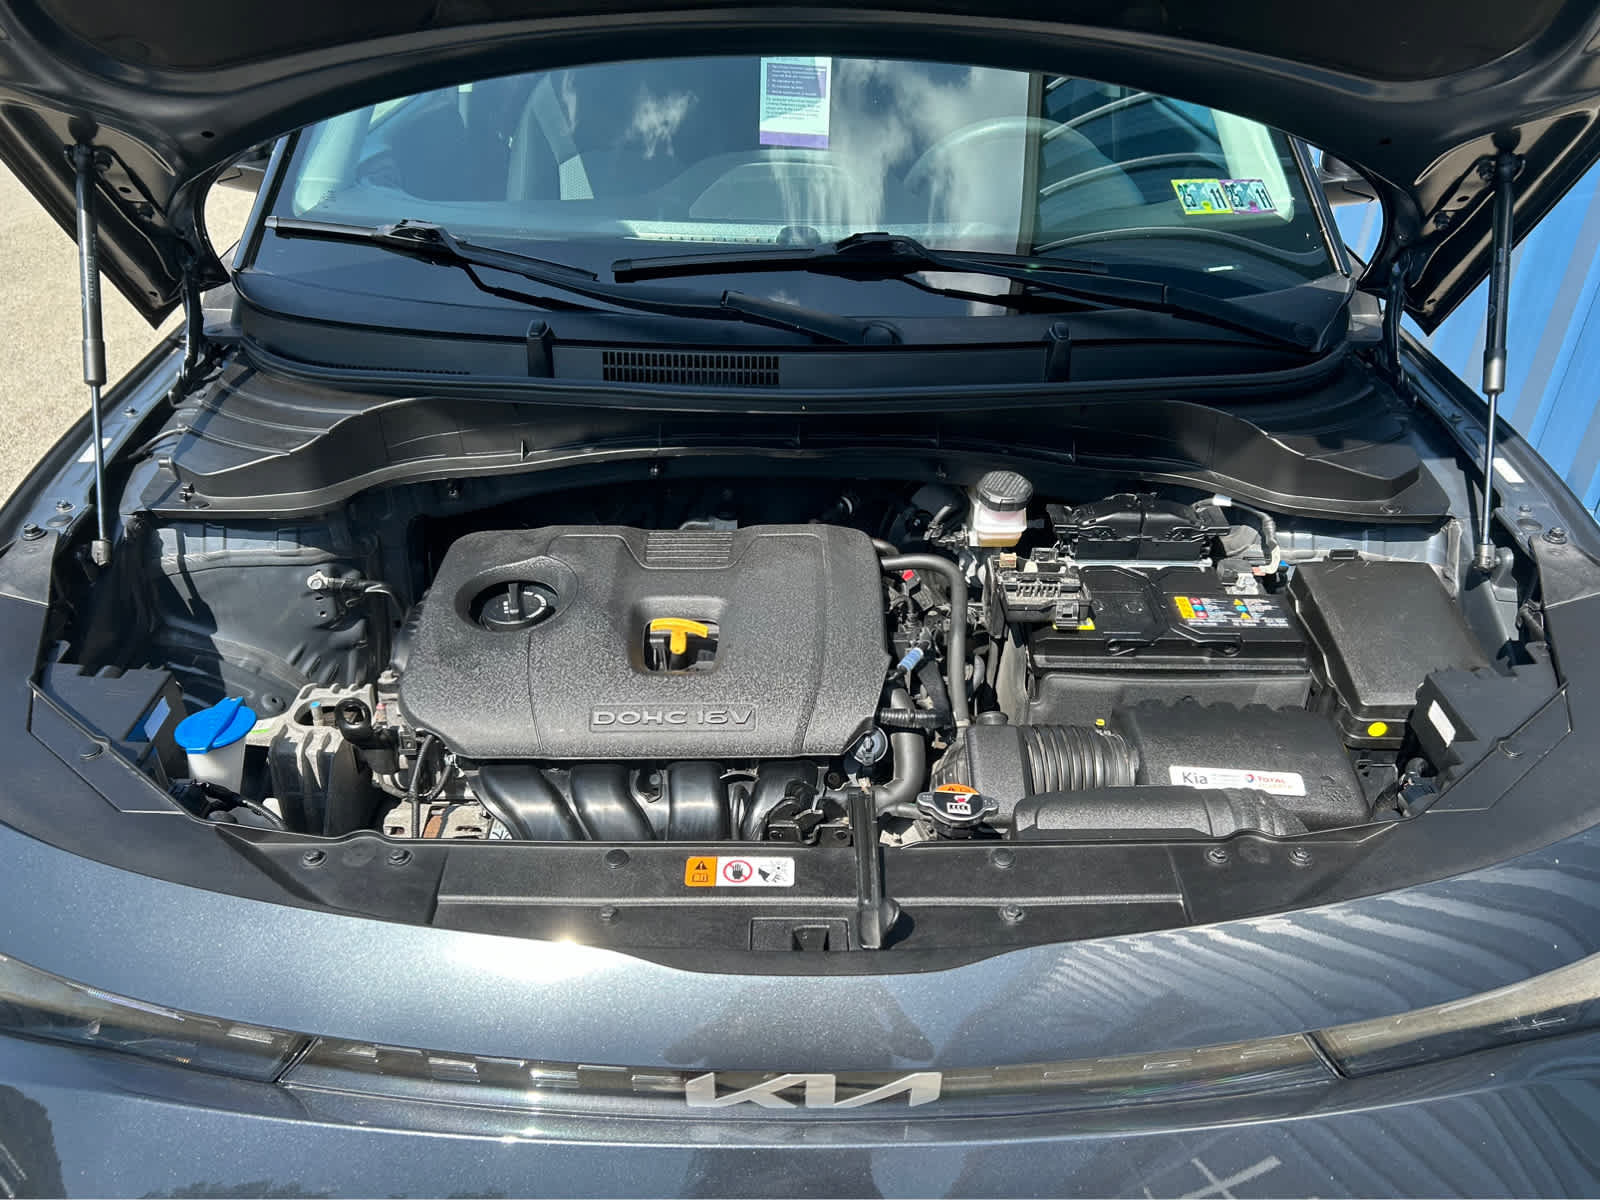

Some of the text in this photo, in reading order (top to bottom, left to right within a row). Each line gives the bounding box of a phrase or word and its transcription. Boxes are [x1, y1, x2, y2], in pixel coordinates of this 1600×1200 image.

[1210, 188, 1228, 209] 11
[1255, 188, 1273, 209] 11
[593, 709, 753, 726] DOHC 16V
[1182, 771, 1209, 785] Kia
[1257, 775, 1286, 784] TOTAL
[685, 1072, 942, 1109] KIA
